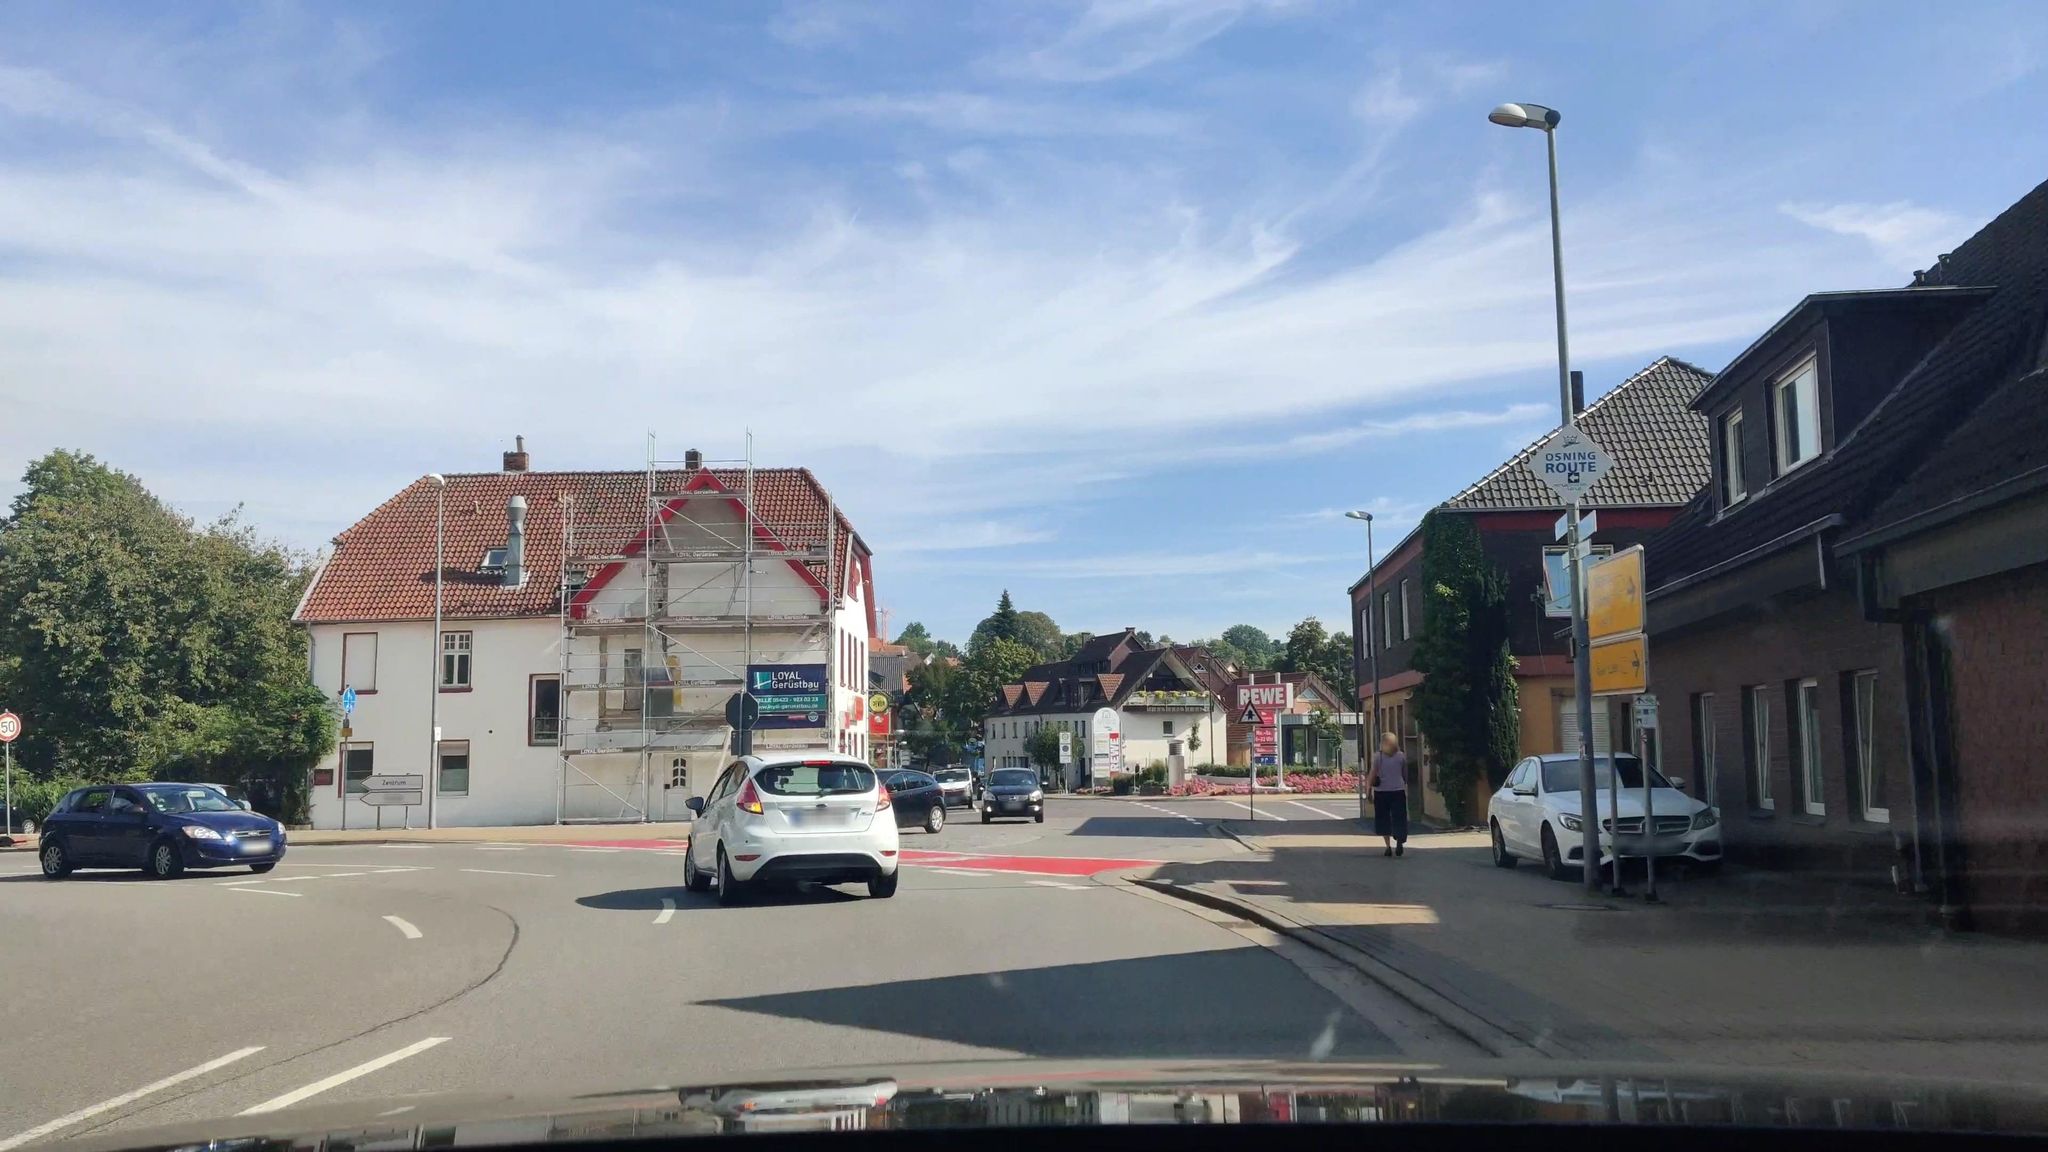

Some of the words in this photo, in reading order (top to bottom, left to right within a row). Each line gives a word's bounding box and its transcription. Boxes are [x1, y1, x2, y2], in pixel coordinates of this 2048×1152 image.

[1546, 452, 1596, 462] OSNING
[1546, 462, 1597, 474] ROUTE
[772, 672, 802, 680] LOYAL
[772, 680, 819, 689] Gerüstbau
[1240, 688, 1285, 706] REWE
[1, 721, 15, 733] 50
[1110, 738, 1119, 771] REWE
